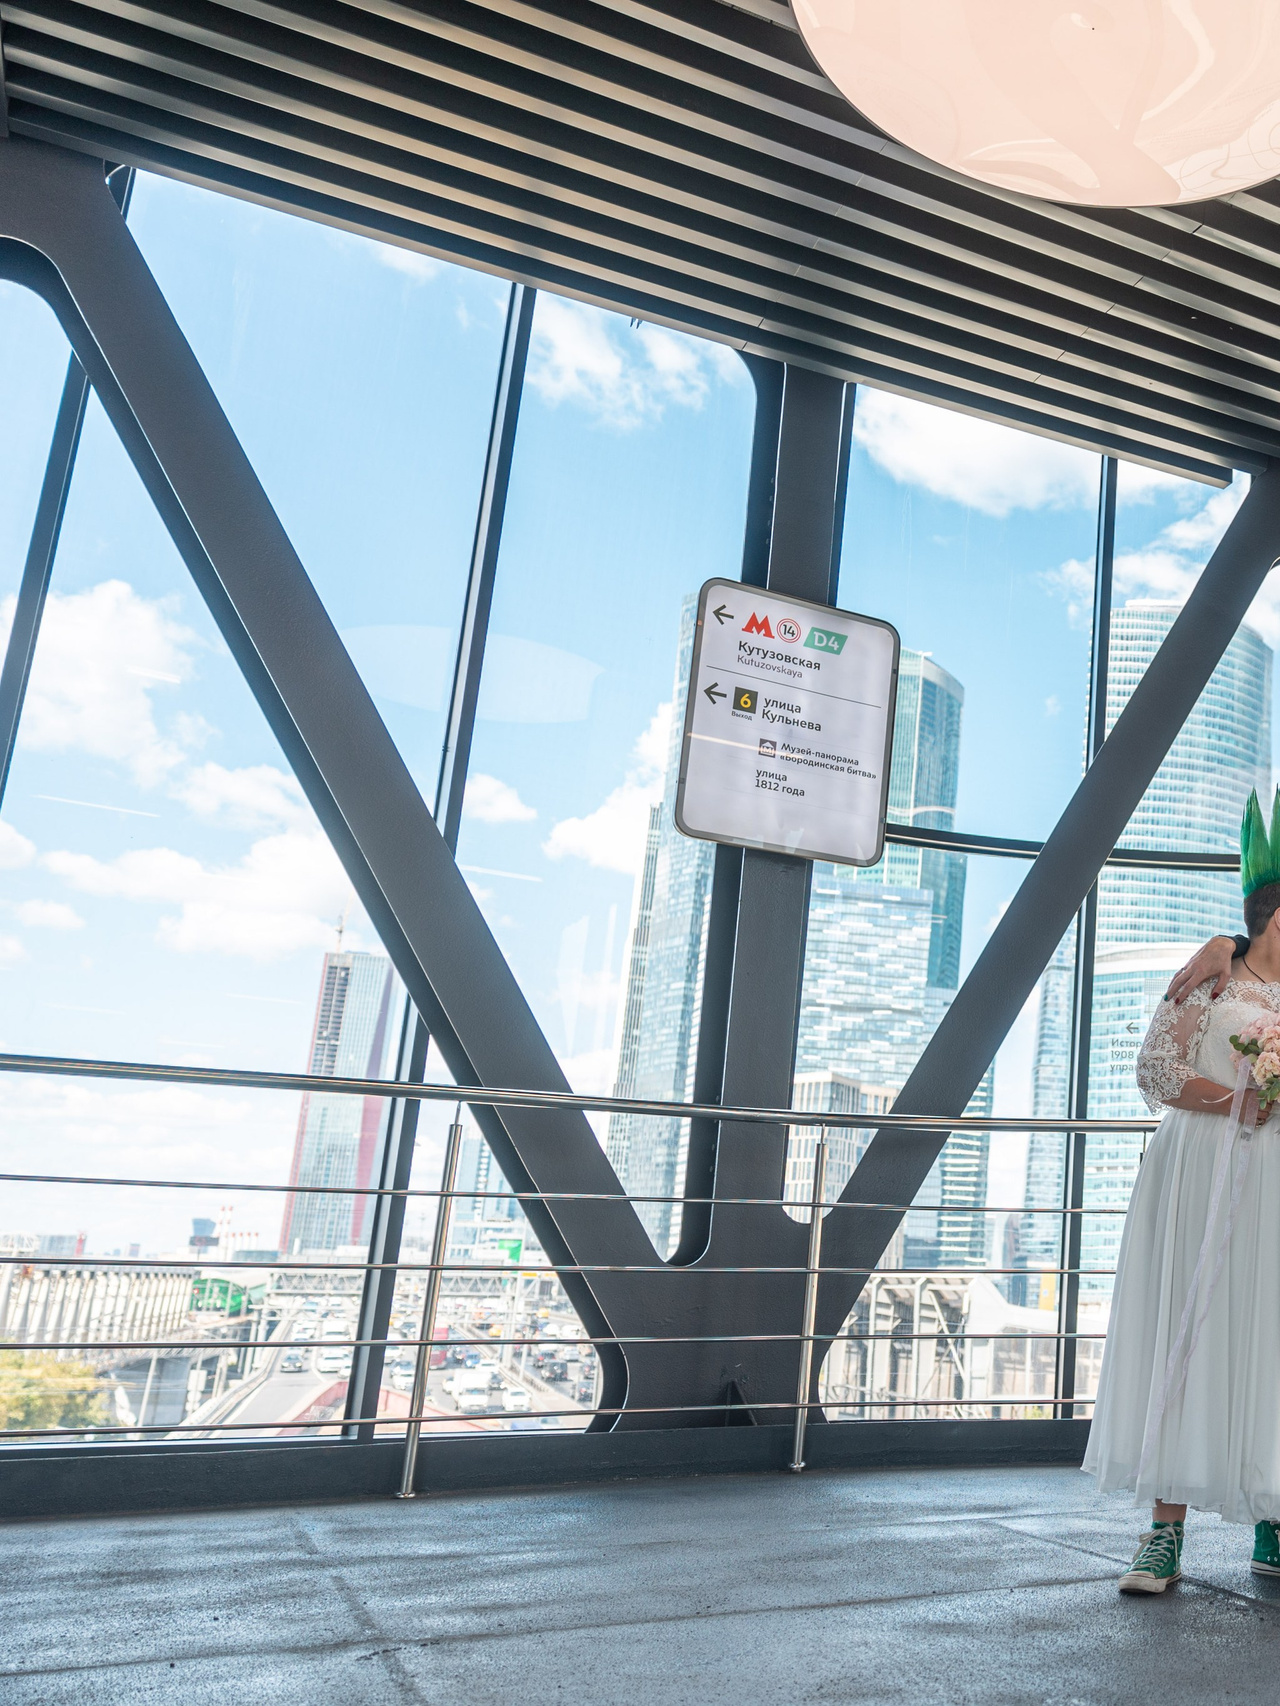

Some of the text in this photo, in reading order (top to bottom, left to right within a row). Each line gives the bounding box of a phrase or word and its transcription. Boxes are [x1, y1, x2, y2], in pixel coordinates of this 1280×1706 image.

[781, 624, 796, 638] 14
[812, 631, 840, 651] D4
[738, 640, 821, 671] Кутузовская
[737, 654, 803, 679] Kutuzovskaya
[740, 693, 752, 708] 6
[764, 697, 802, 714] улица
[731, 710, 753, 721] Выход
[761, 708, 822, 732] Кульнева
[780, 742, 859, 766] Музей-панорама
[755, 768, 788, 782] улица
[846, 765, 877, 780] битва»
[755, 778, 806, 797] 1812 года
[1111, 1038, 1142, 1049] Истор
[1111, 1050, 1134, 1059] 1908
[1110, 1063, 1136, 1072] упра
